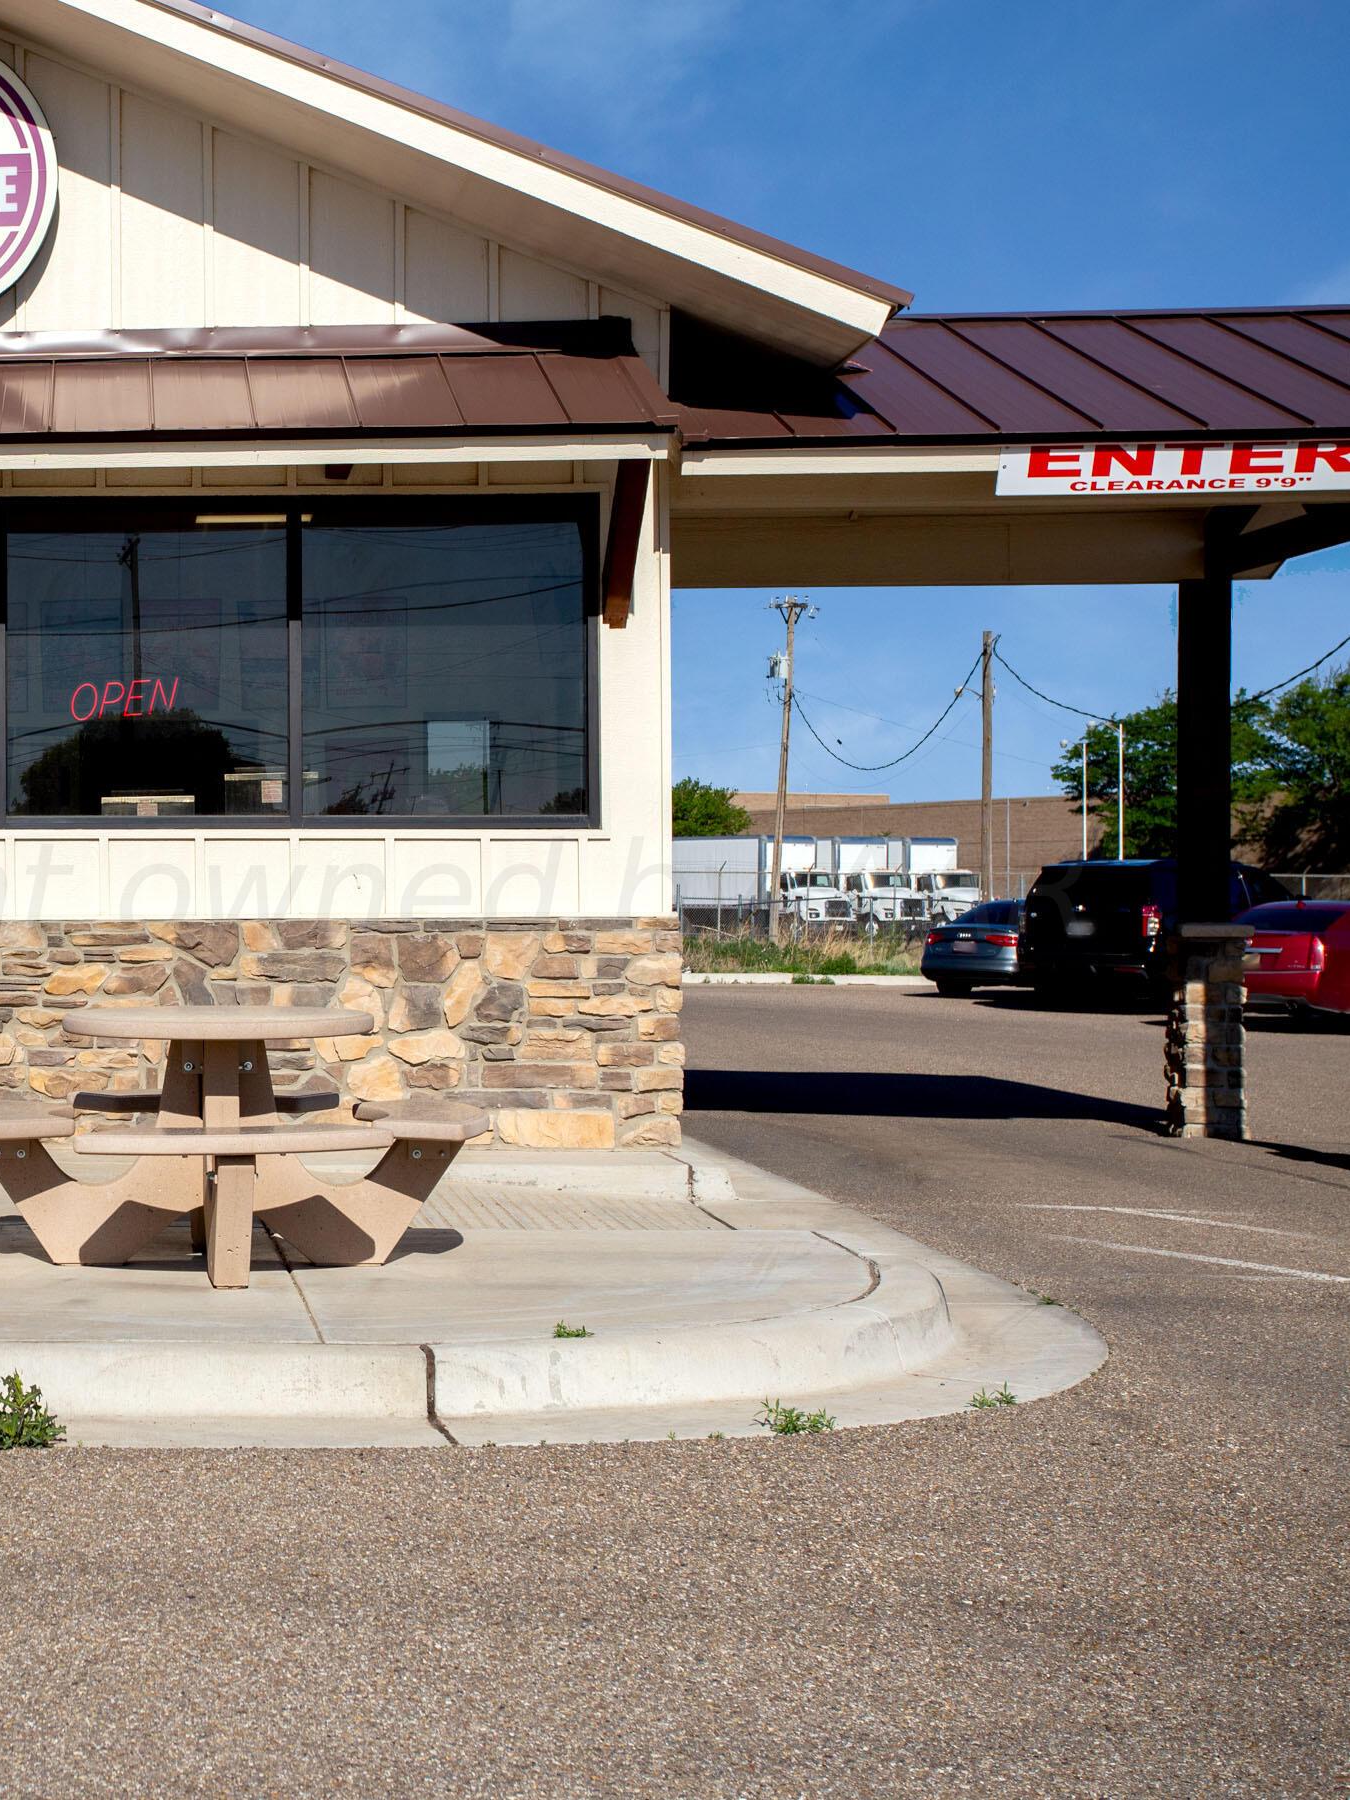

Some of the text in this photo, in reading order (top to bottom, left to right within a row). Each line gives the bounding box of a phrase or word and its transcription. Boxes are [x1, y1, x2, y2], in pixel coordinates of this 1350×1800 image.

[1027, 440, 1350, 478] ENTER
[1069, 478, 1246, 492] CLEARANCE
[70, 677, 179, 722] OPEN
